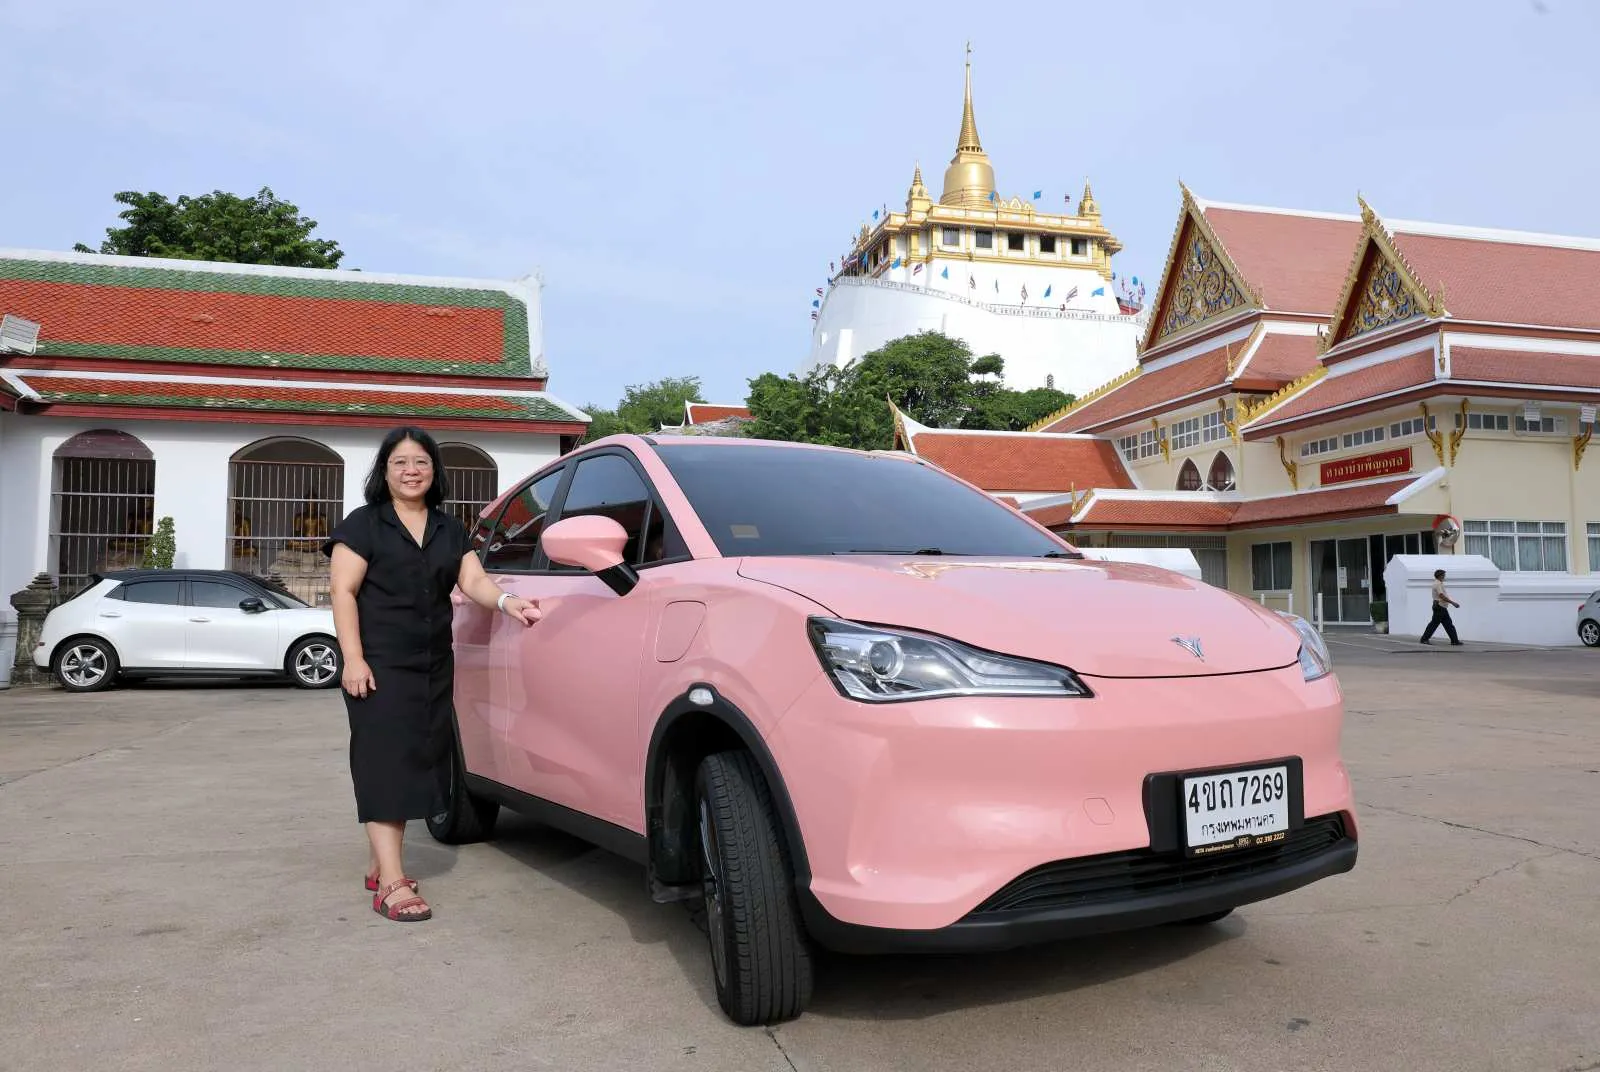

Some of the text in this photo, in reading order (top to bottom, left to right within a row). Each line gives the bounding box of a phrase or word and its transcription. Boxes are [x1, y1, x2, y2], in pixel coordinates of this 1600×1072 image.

[1188, 772, 1284, 813] 4ขถ 7269
[1201, 814, 1275, 838] กรุงเทพมหานคร
